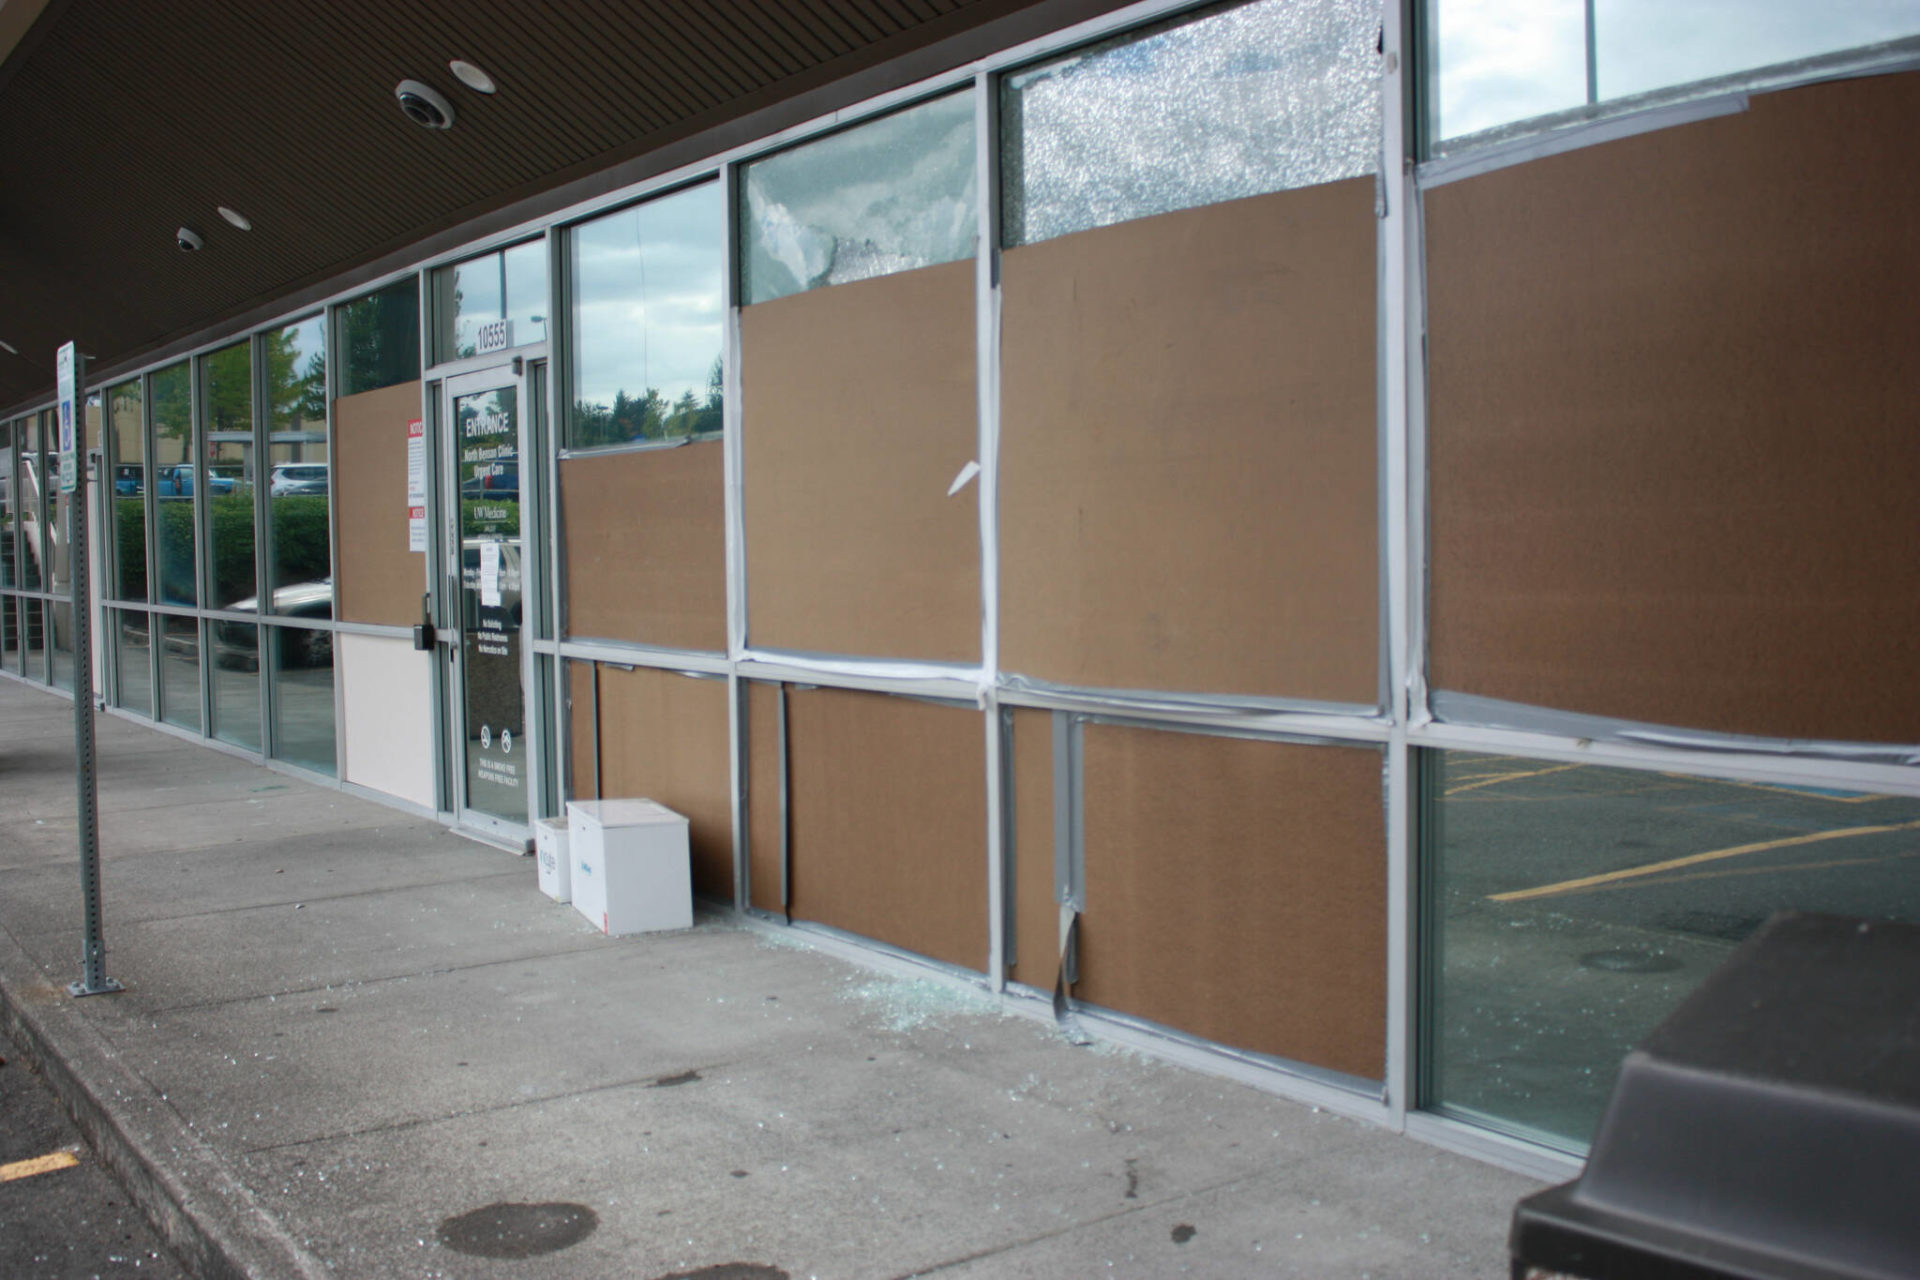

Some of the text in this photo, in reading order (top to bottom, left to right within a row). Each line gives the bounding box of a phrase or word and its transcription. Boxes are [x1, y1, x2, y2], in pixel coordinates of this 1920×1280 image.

[478, 322, 505, 349] 10555
[410, 422, 423, 434] NOTIC
[466, 412, 509, 438] ENTRANCE
[465, 448, 478, 462] North
[498, 444, 513, 457] Clinic
[474, 463, 504, 479] Urgent Care
